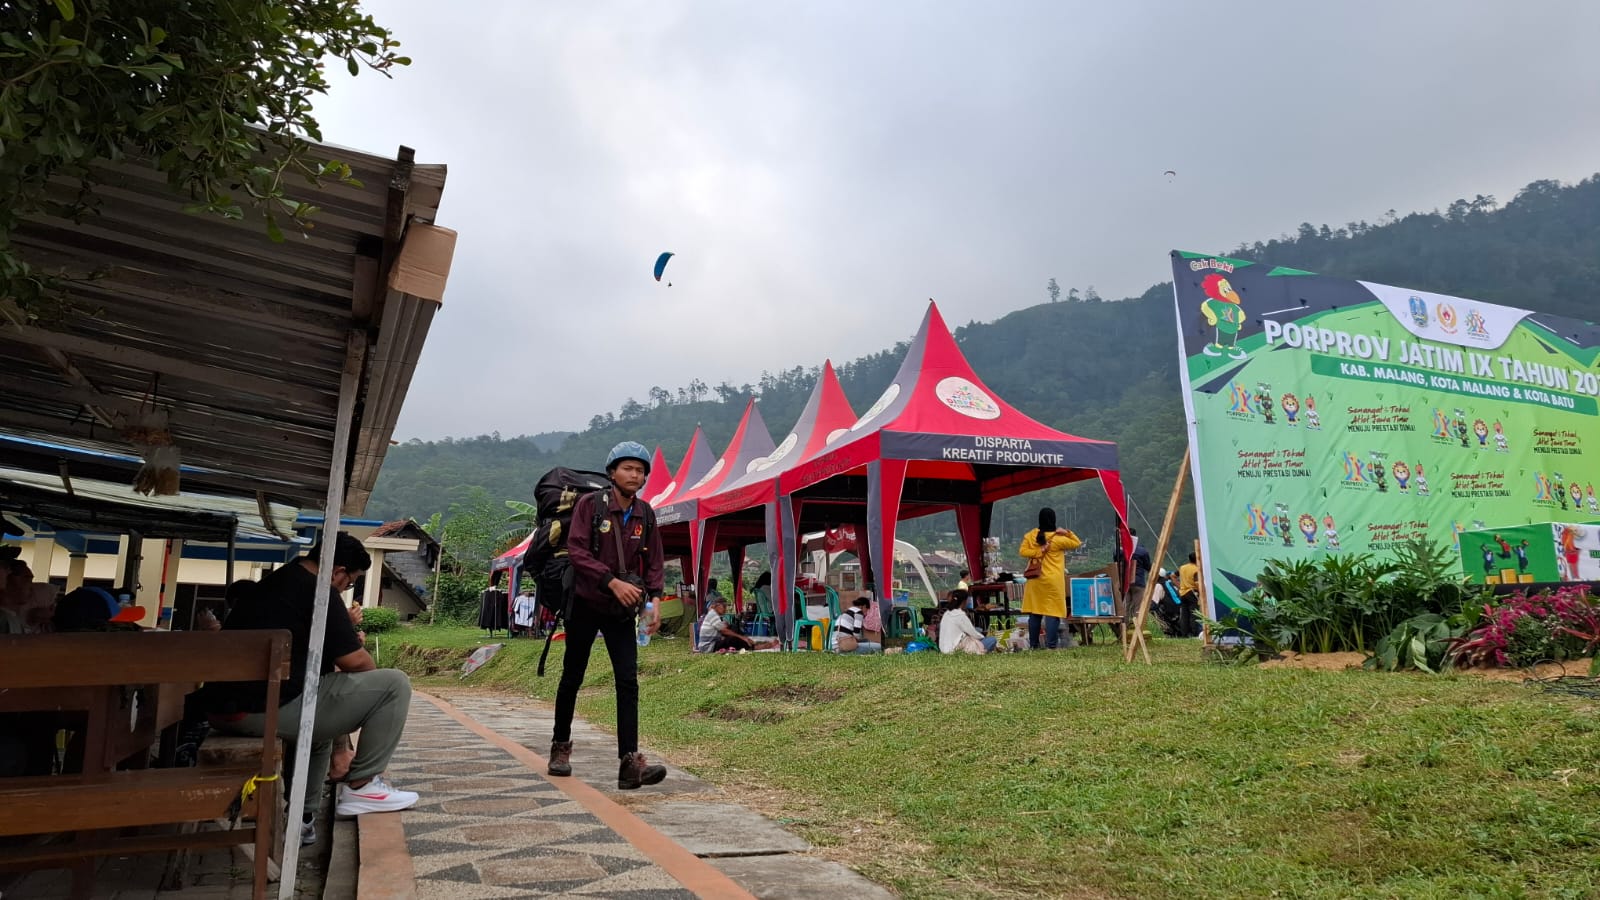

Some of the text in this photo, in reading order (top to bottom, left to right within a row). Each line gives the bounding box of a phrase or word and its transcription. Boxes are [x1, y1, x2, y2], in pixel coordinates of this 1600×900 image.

[1264, 320, 1600, 396] PORPROV JATIM IX TAHUN 20
[1340, 363, 1575, 408] KAB. MALANG, KOTA MALANG & KOTA BATU
[943, 448, 1064, 464] KREATIF PRODUKTIF
[975, 436, 1032, 450] DISPARTA
